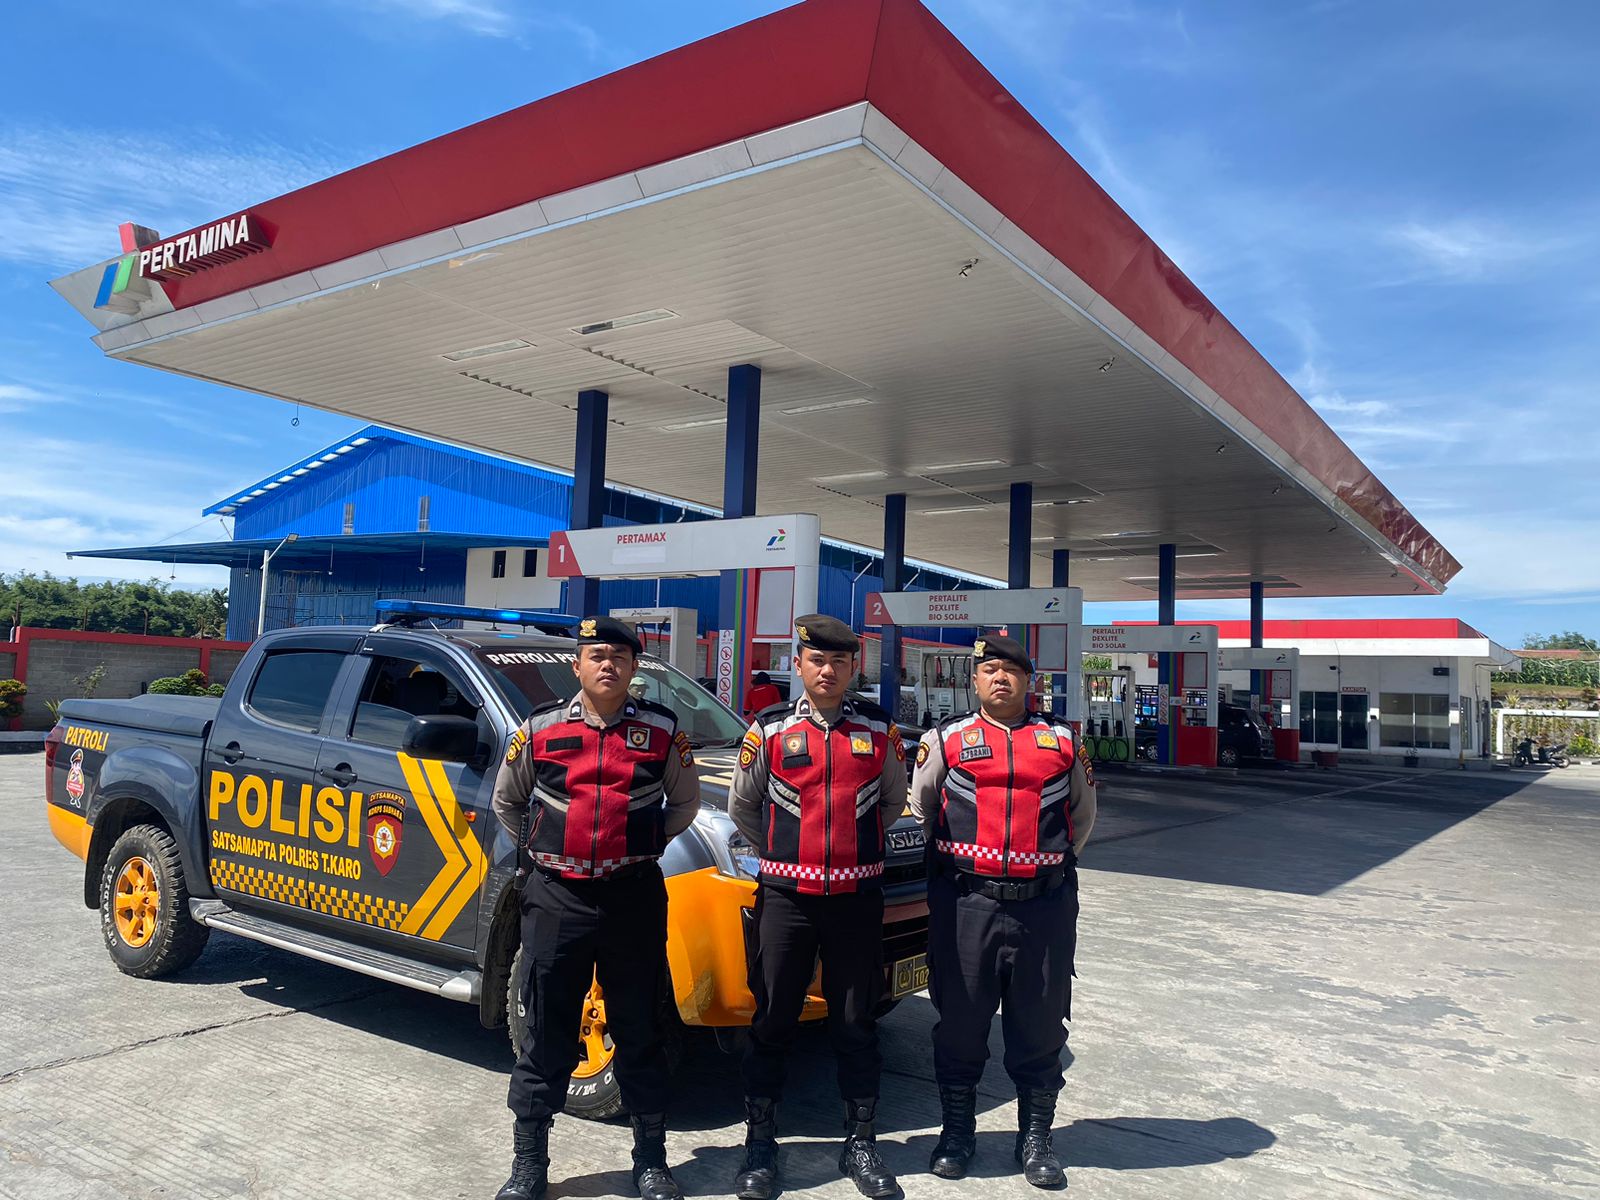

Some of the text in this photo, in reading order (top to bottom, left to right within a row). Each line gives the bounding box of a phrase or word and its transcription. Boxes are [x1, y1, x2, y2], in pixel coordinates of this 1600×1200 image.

[139, 214, 249, 277] PERTAMINA
[616, 531, 667, 544] PERTAMAX
[558, 544, 565, 563] 1
[929, 594, 968, 602] PERTALITE
[873, 602, 882, 615] 2
[929, 613, 969, 621] BIO SOLAR
[486, 653, 556, 665] PATROLI
[64, 726, 110, 752] PATROLI
[208, 770, 364, 848] POLISI
[888, 829, 927, 849] ISUZ
[212, 829, 362, 881] SATSAMAPTA POLRES T.KARO
